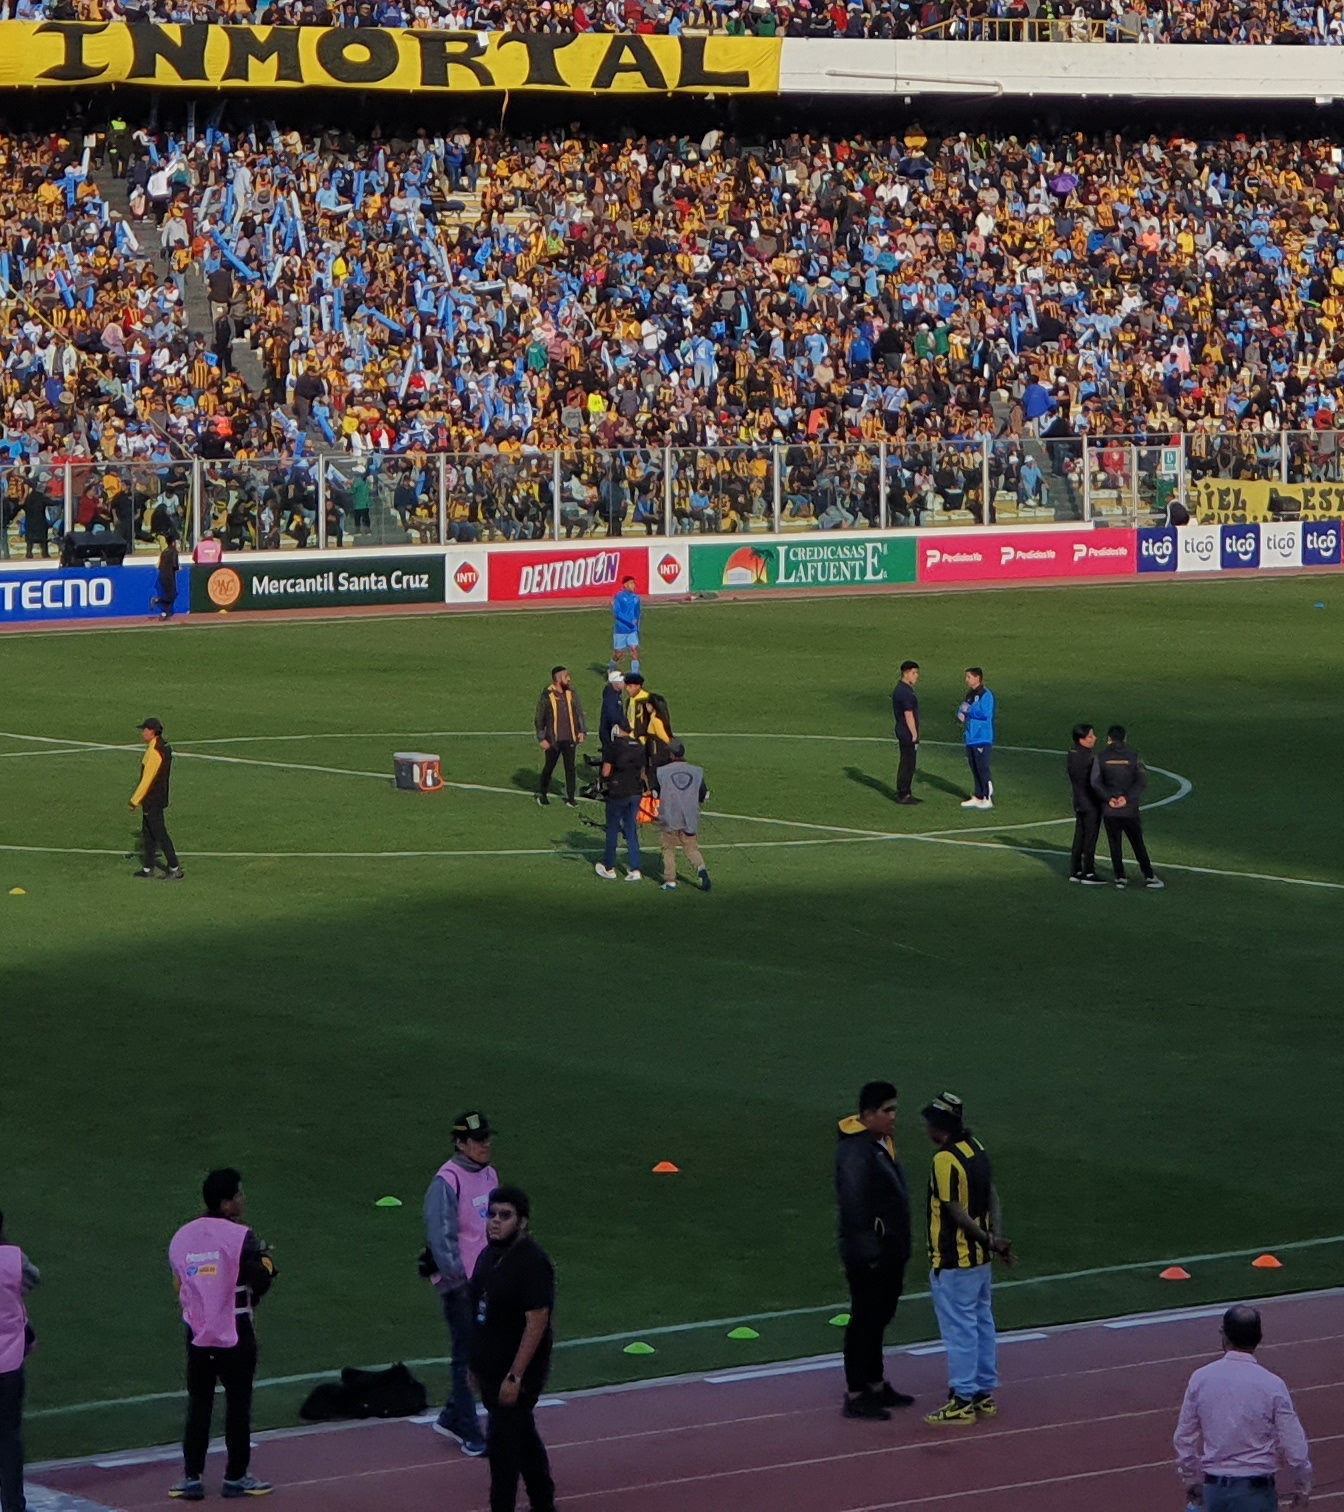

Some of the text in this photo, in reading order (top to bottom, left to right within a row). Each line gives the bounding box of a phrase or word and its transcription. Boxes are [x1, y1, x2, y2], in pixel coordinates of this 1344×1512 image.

[33, 21, 749, 88] INMORTAL
[789, 545, 865, 561] CREDICASAS
[660, 563, 679, 575] INTI
[252, 571, 334, 596] Mercantil
[338, 571, 388, 592] Santa
[391, 569, 430, 590] Cruz
[456, 571, 477, 584] INTI
